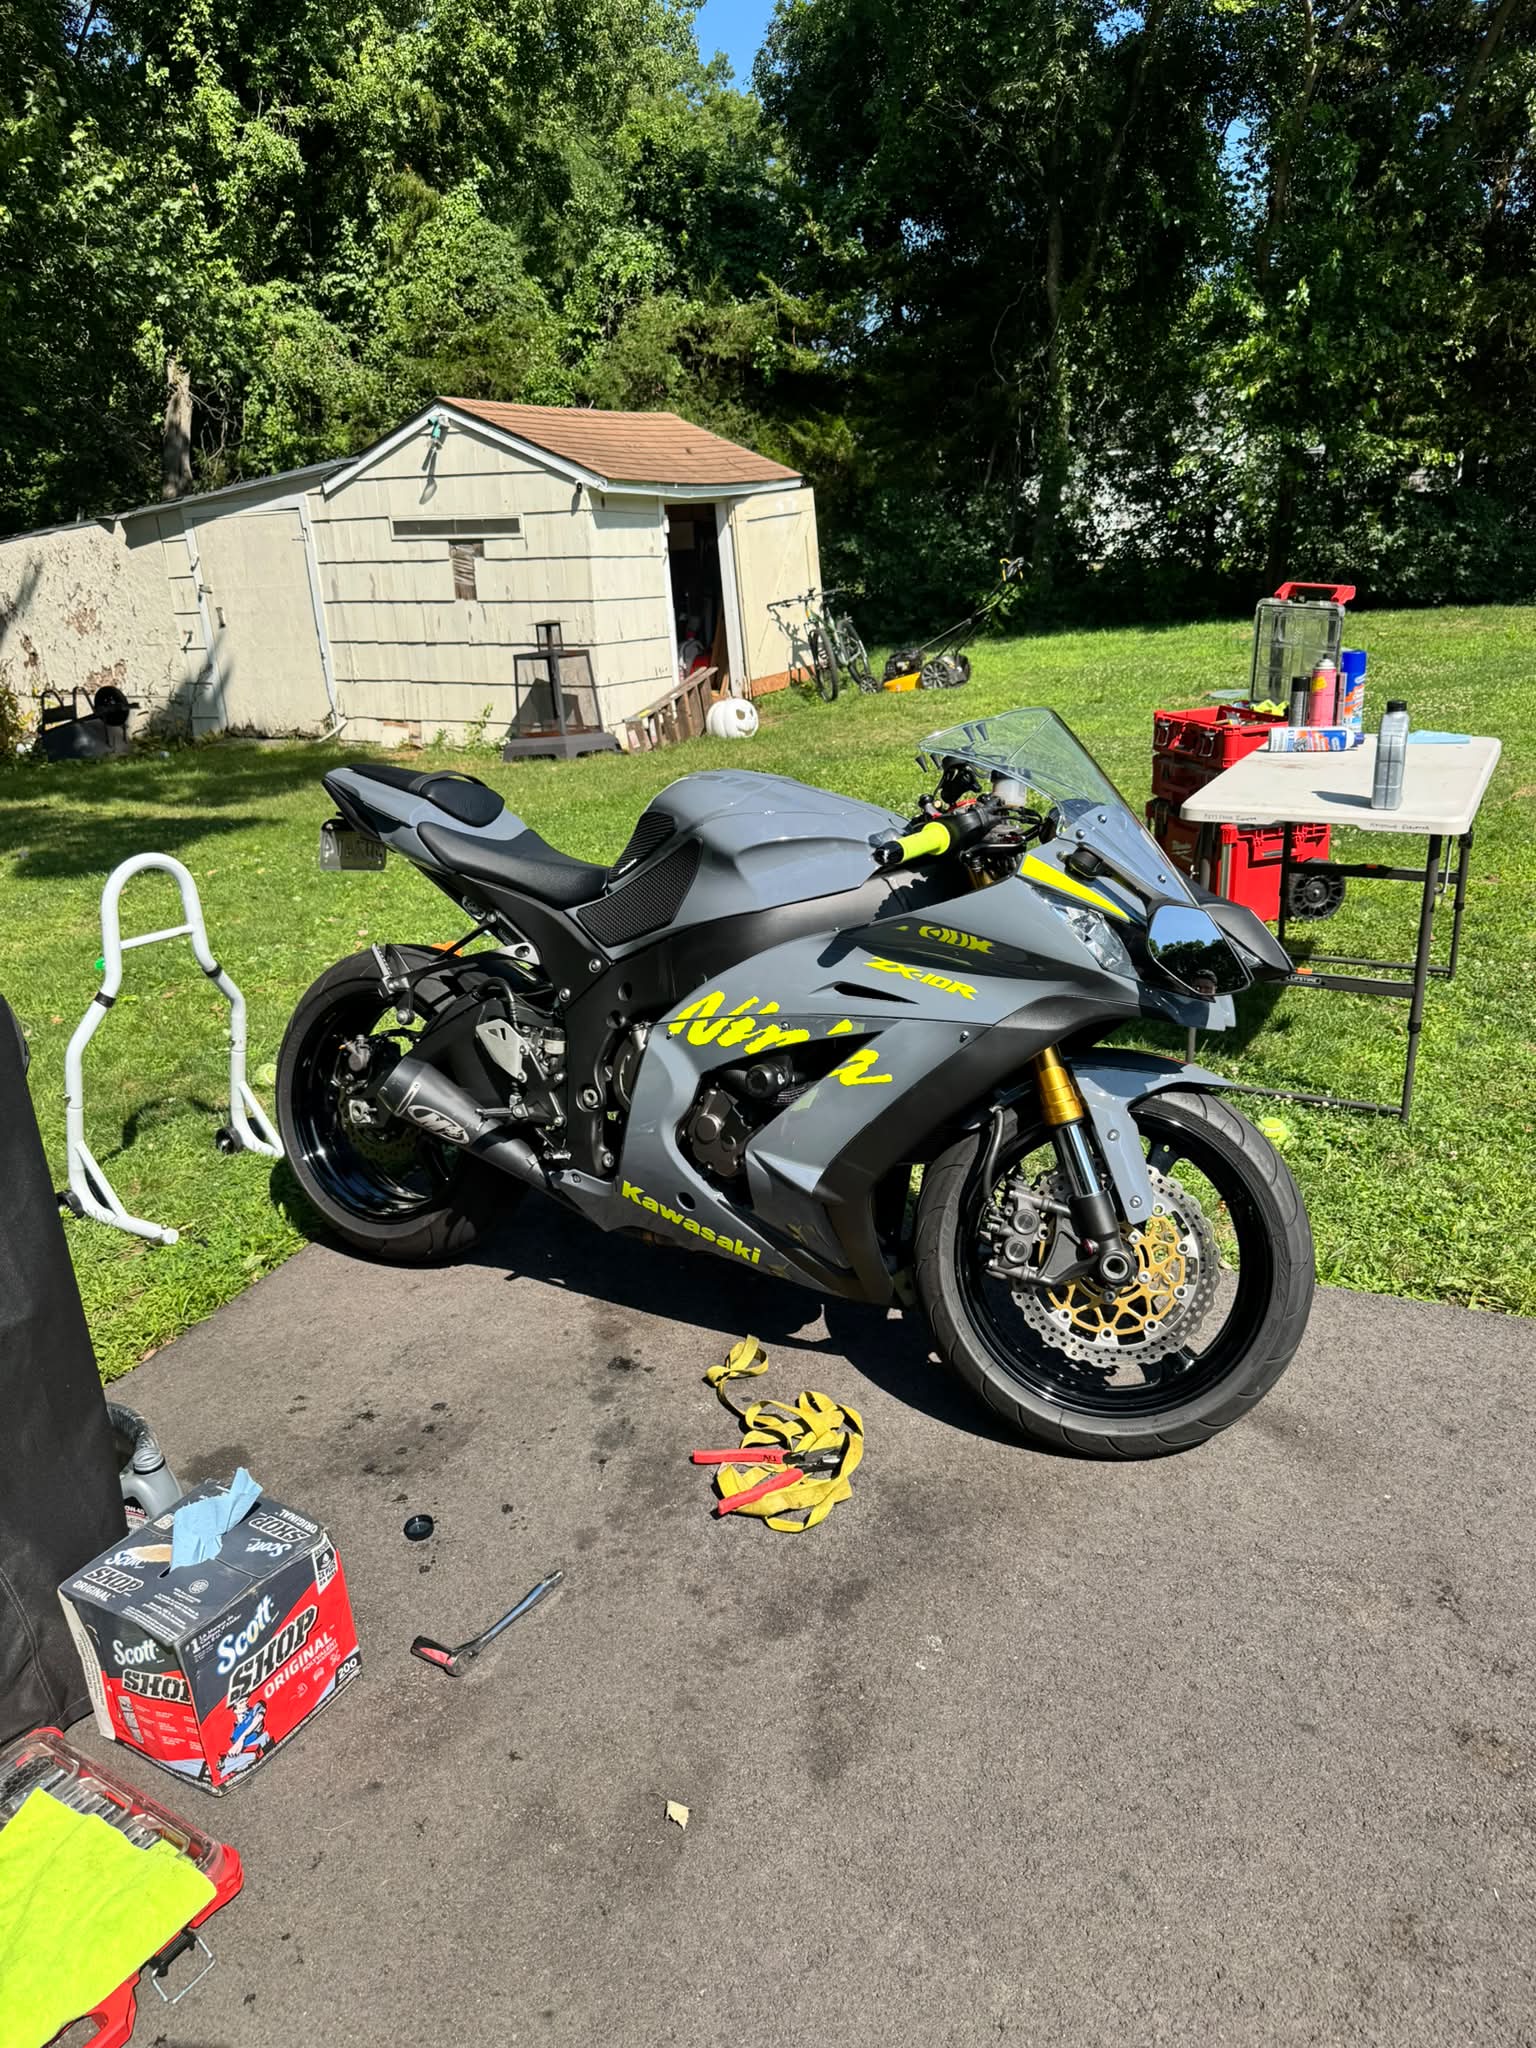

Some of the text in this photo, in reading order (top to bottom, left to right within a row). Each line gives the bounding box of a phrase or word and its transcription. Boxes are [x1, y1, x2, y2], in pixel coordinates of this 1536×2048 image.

[864, 957, 978, 1000] ZX-10R
[622, 1180, 761, 1265] Kawasaki
[249, 1515, 311, 1542] SHOP
[279, 1508, 318, 1534] ORIGINAL
[245, 1541, 292, 1557] Scott
[73, 1580, 113, 1602] ORIGINAL
[83, 1566, 144, 1593] SHOP
[218, 1594, 273, 1674] Scott
[112, 1639, 158, 1665] Scott
[226, 1604, 318, 1708] SHOP
[264, 1632, 333, 1699] ORIGINAL
[338, 1658, 357, 1679] 200
